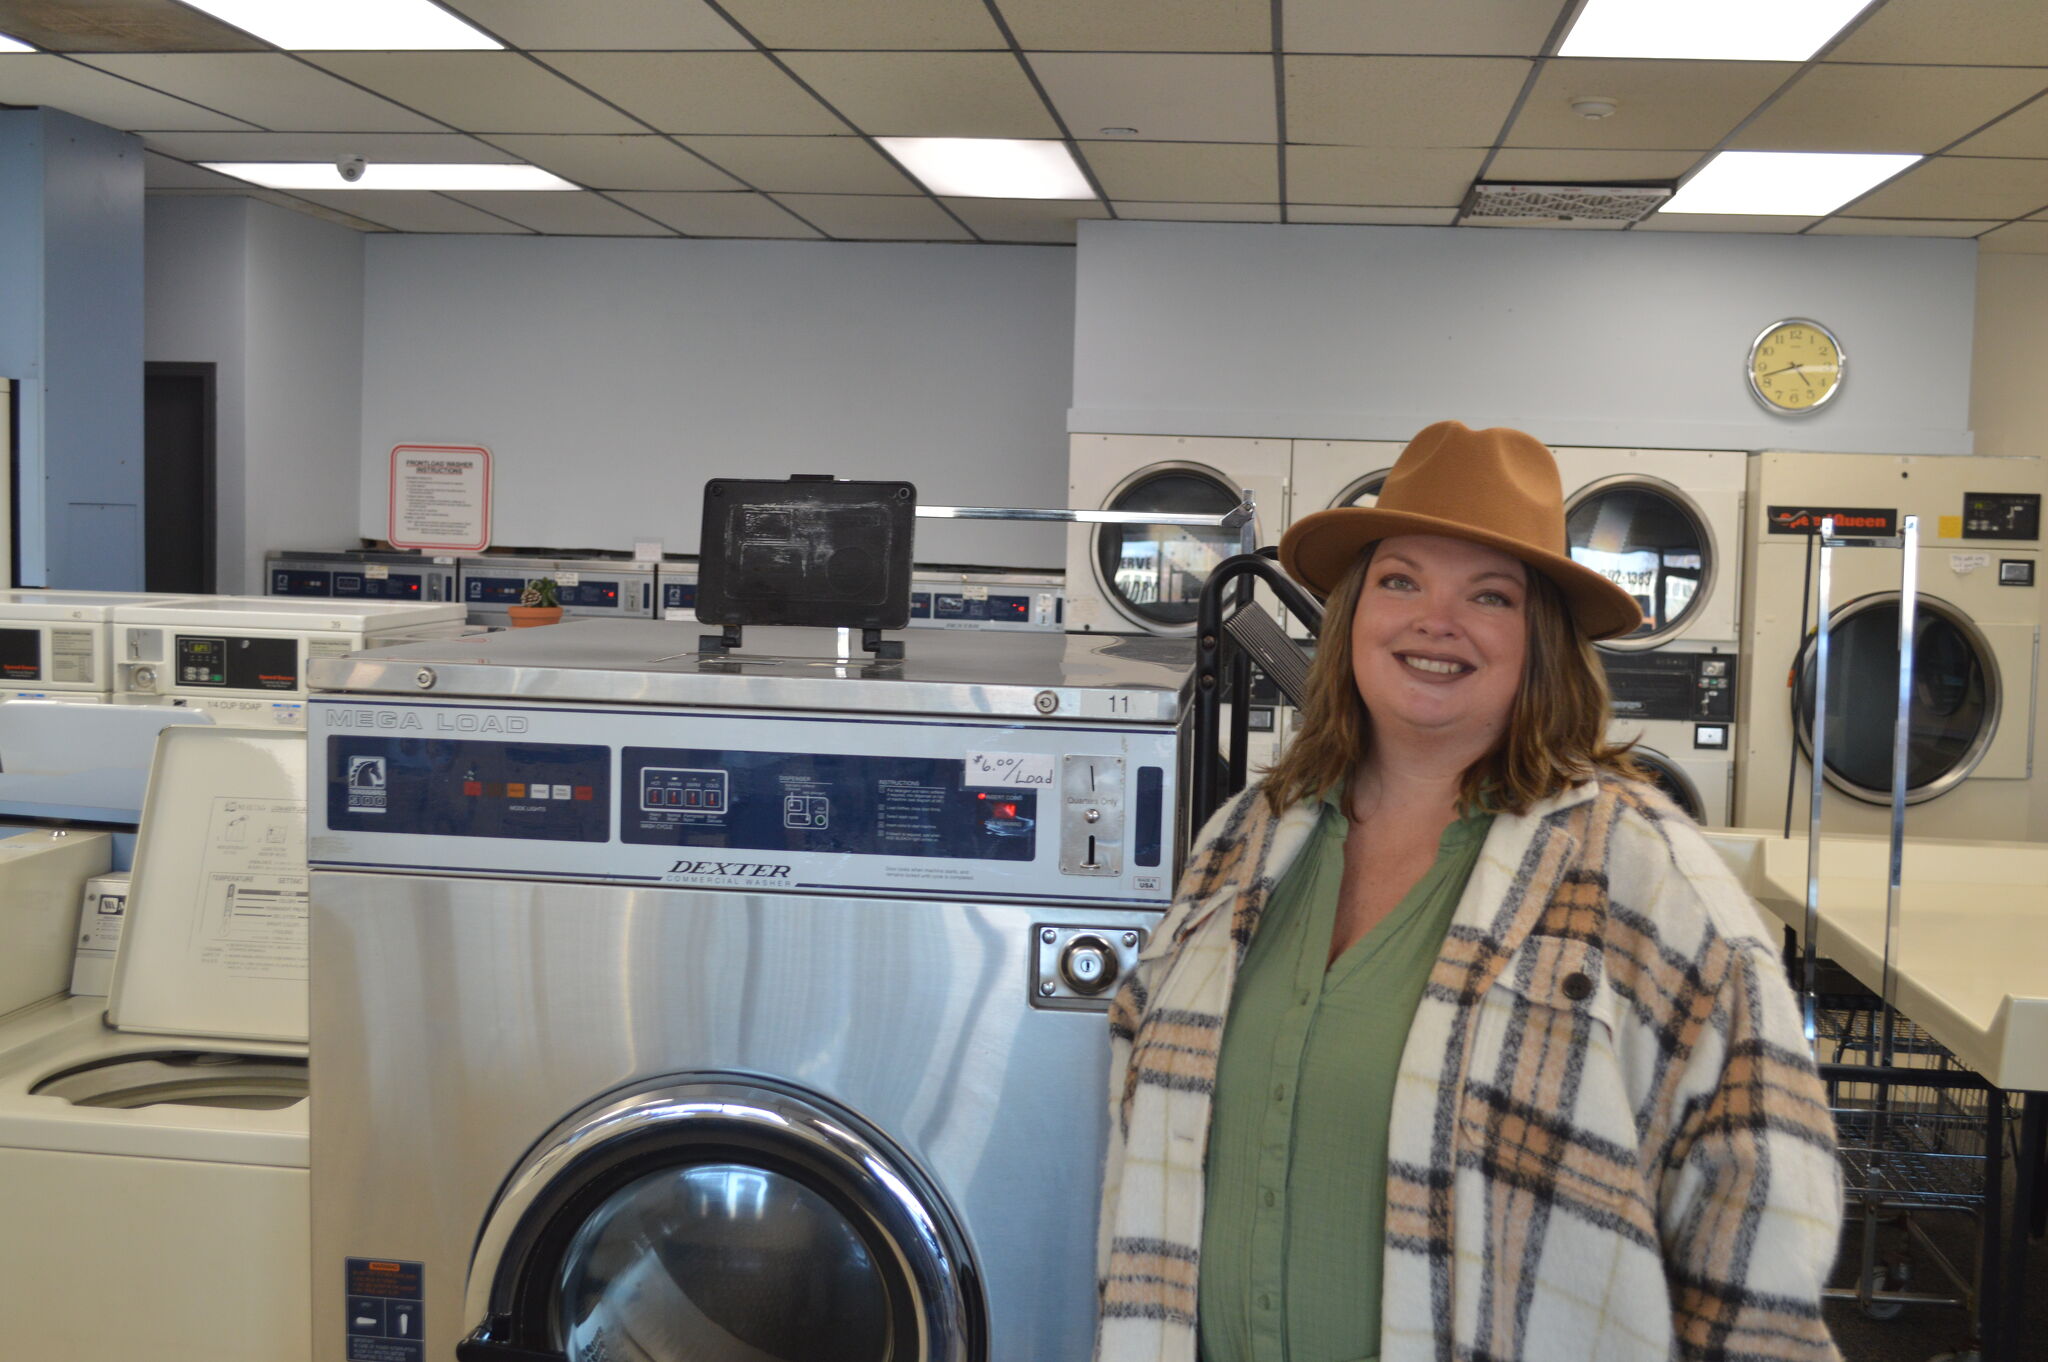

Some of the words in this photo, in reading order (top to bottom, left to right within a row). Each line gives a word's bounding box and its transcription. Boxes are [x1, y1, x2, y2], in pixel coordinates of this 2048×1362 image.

[1834, 514, 1887, 528] Queen
[1108, 695, 1129, 714] 11
[326, 709, 422, 730] MEGA
[436, 713, 529, 734] LOAD
[668, 860, 792, 878] DEXTER
[667, 875, 739, 885] COMMERCIAL
